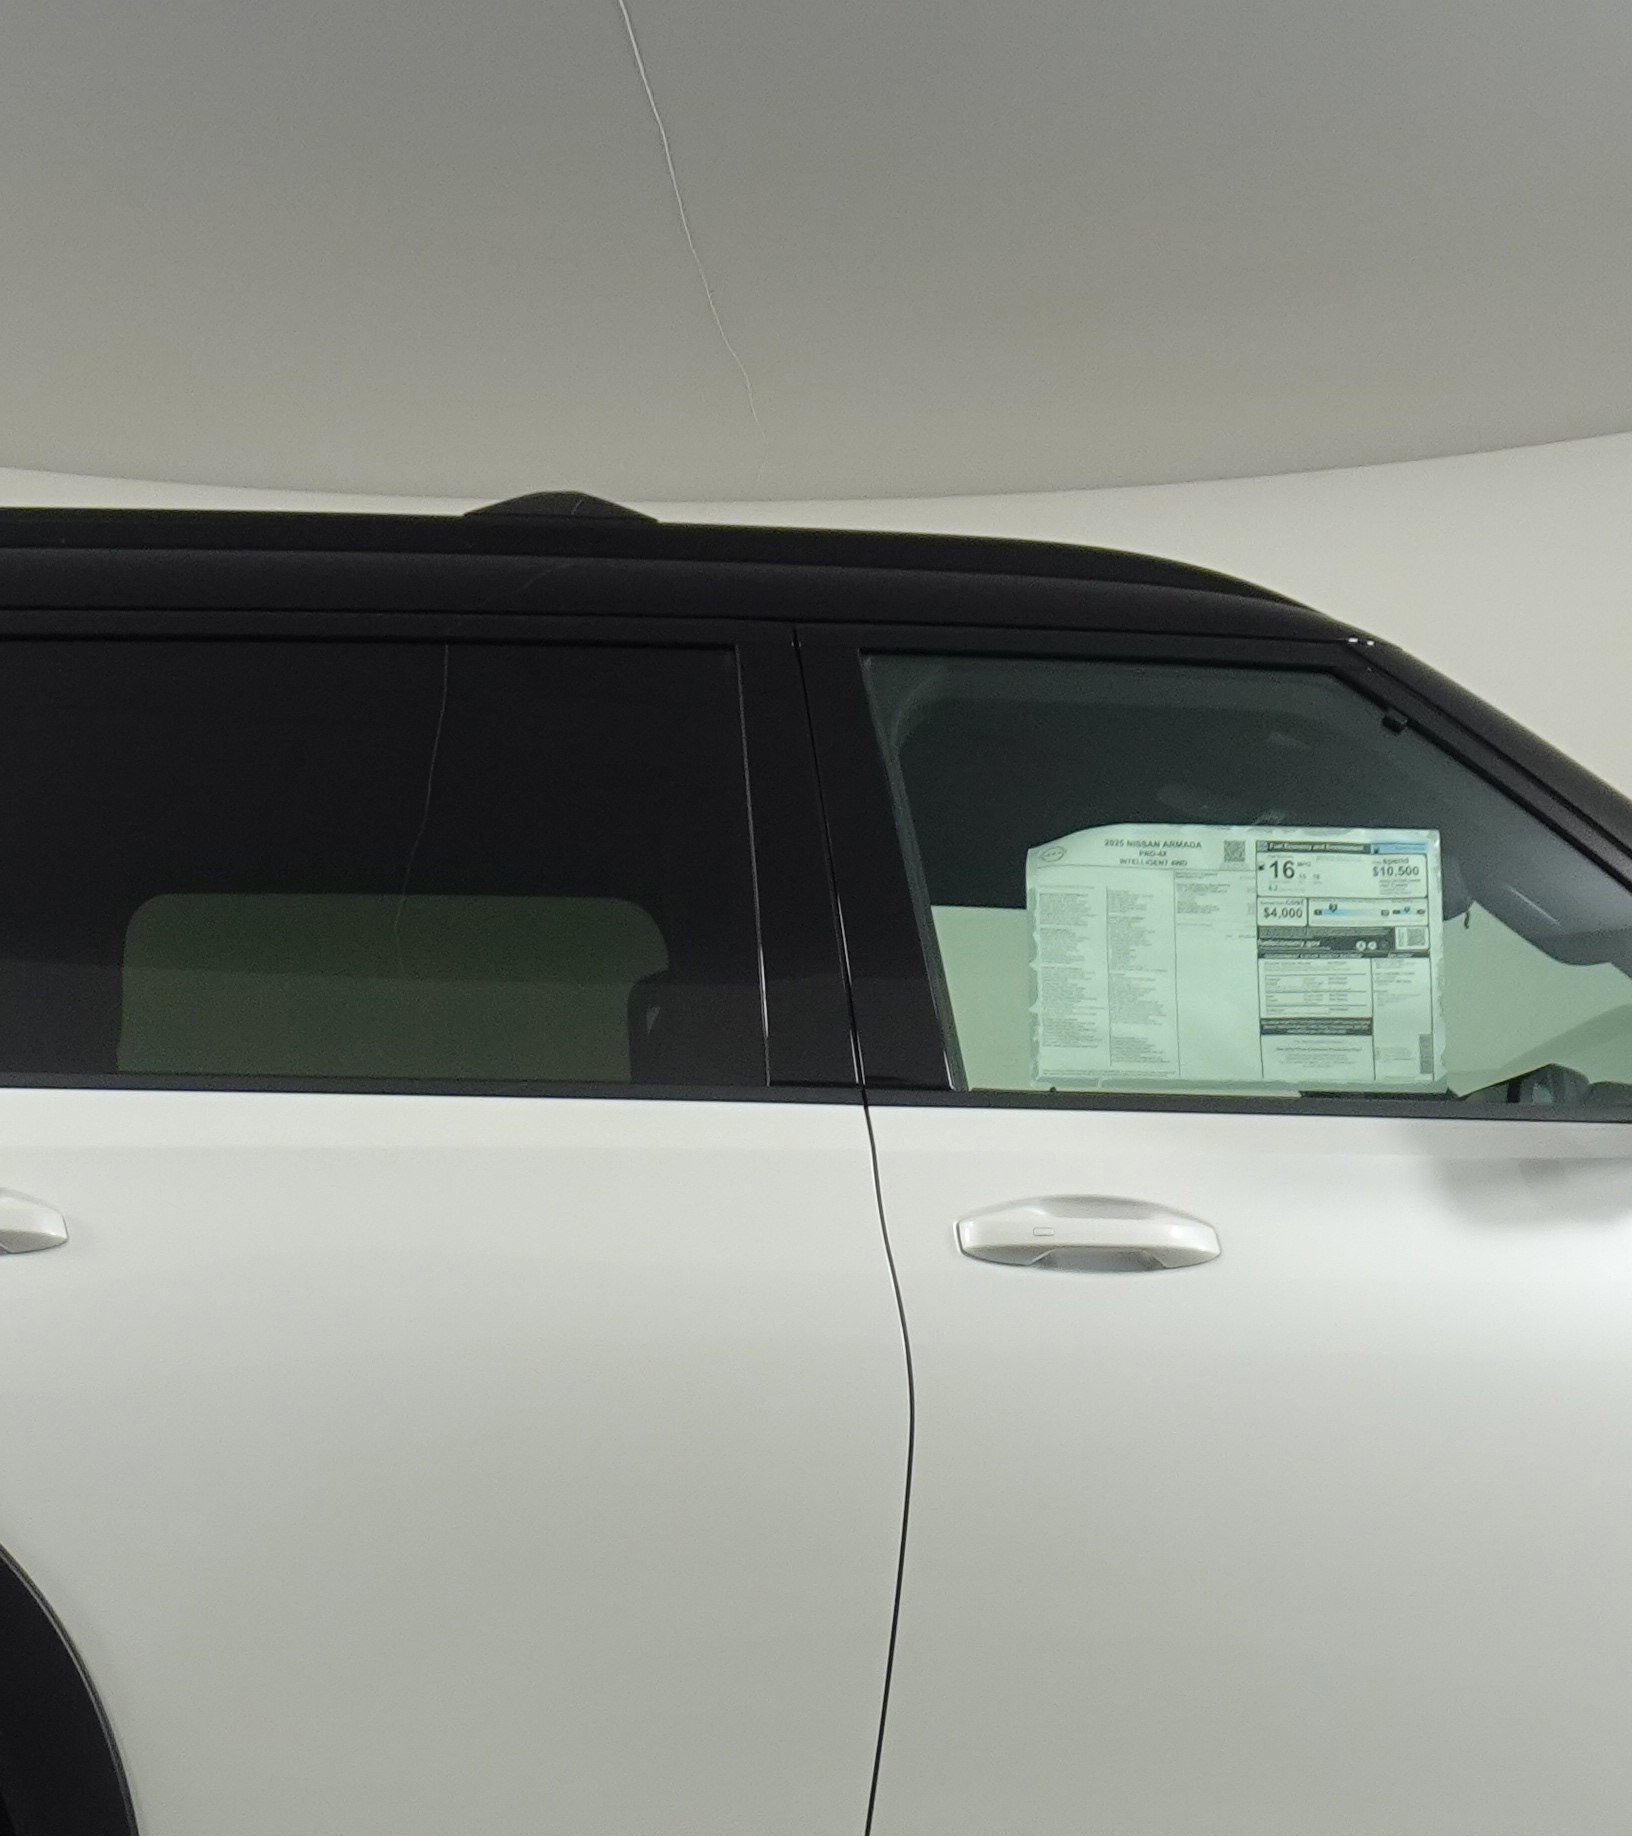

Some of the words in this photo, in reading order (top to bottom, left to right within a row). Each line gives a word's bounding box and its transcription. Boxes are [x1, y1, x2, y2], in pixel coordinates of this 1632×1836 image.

[1104, 839, 1125, 847] 2025
[1126, 840, 1161, 849] NISSAN
[1162, 841, 1202, 849] ARMADA
[1268, 859, 1296, 880] 16
[1372, 866, 1420, 878] $10,500
[1263, 907, 1303, 920] $4,000
